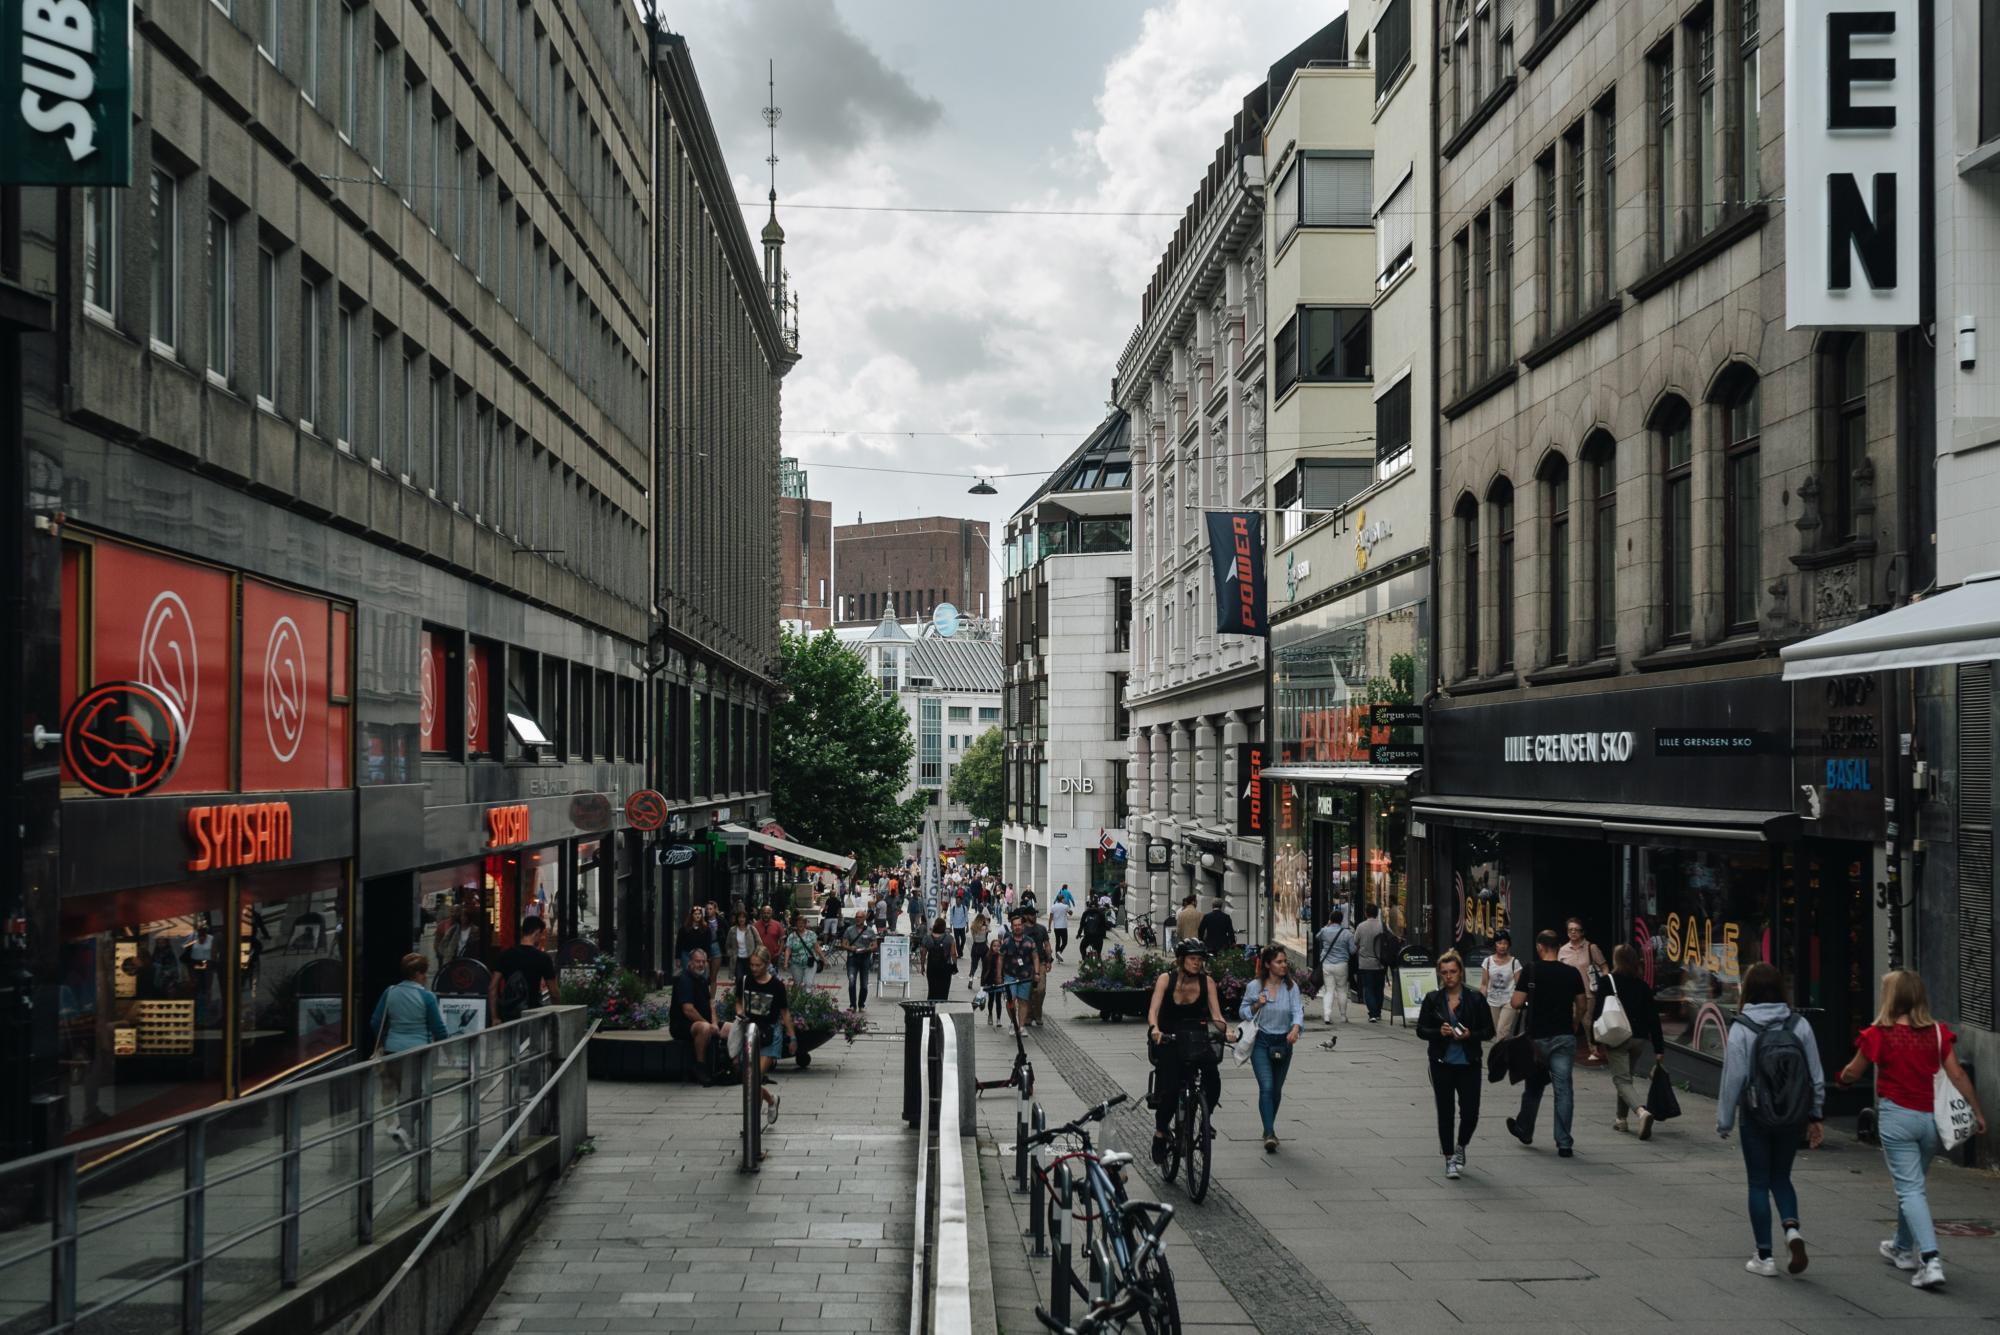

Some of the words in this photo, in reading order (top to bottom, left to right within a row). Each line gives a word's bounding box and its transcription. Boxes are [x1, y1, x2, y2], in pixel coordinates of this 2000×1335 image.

[1232, 516, 1256, 628] POWER
[1381, 711, 1405, 722] argus
[1381, 751, 1405, 761] argus
[1505, 735, 1534, 762] LILLE
[1534, 732, 1600, 763] GRENSEN
[1600, 731, 1635, 762] SKO
[1659, 738, 1679, 746] LILLE
[1682, 738, 1728, 746] GRENSEN
[1731, 738, 1752, 746] SKO
[1250, 750, 1261, 829] POWER
[1826, 757, 1872, 791] BASAL
[188, 801, 292, 871] SYNSAM
[486, 804, 529, 848] SYNSAM
[1465, 896, 1506, 936] SALE
[1667, 912, 1740, 976] SALE
